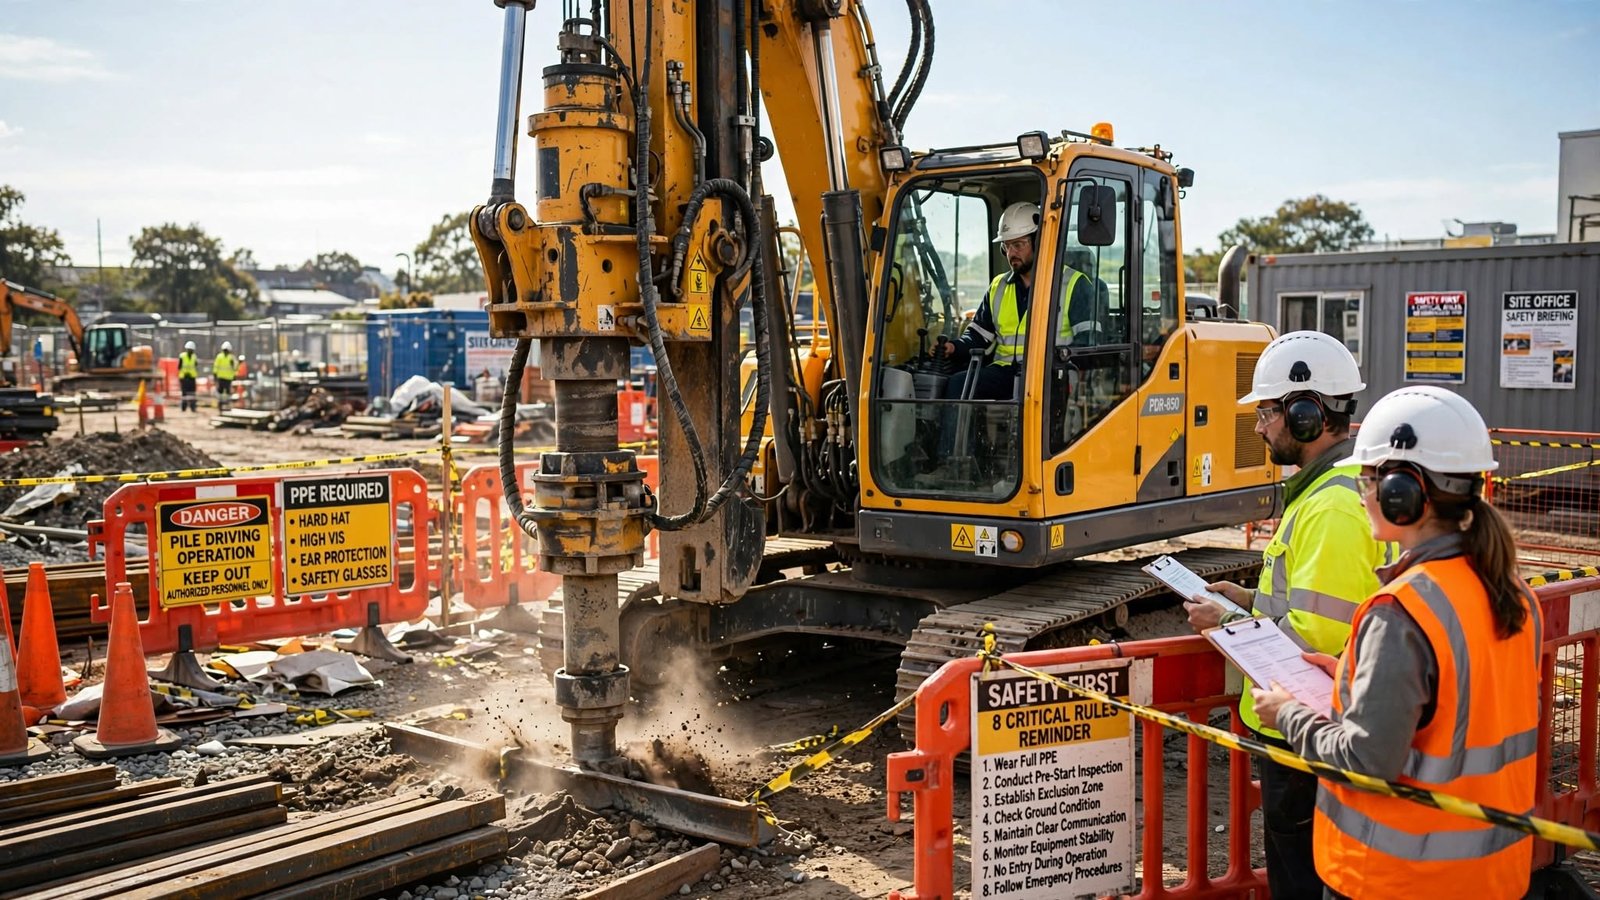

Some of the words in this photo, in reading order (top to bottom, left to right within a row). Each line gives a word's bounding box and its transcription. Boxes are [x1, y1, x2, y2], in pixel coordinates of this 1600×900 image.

[1508, 296, 1531, 308] SITE
[1534, 294, 1570, 308] OFFICE
[1506, 312, 1535, 322] SAFETY
[1537, 310, 1574, 321] BRIEFING
[1149, 397, 1179, 412] PDR-850
[291, 486, 316, 504] PPE
[320, 482, 384, 502] REQUIRED
[180, 506, 250, 524] DANGER
[299, 513, 328, 528] HARD
[331, 511, 350, 525] HAT
[170, 534, 200, 549] PILE
[206, 529, 260, 545] DRIVING
[300, 533, 326, 547] HIGH
[328, 531, 345, 544] VIS
[177, 545, 255, 565] OPERATION
[300, 552, 321, 566] EAR
[324, 546, 387, 564] PROTECTION
[183, 570, 219, 585] KEEP
[224, 566, 251, 581] OUT
[301, 570, 339, 586] SAFETY
[343, 564, 388, 581] GLASSES
[167, 587, 210, 600] AUTHORIZED
[211, 583, 250, 595] PERSONNEL
[252, 580, 268, 590] ONLY
[988, 679, 1061, 708] SAFETY
[1068, 672, 1119, 699] FIRST
[992, 714, 1001, 730] 8
[1006, 706, 1070, 729] CRITICAL
[1075, 702, 1118, 721] RULES
[1020, 723, 1090, 748] REMINDER
[983, 760, 991, 772] 1.
[994, 757, 1018, 771] Wear
[1020, 753, 1037, 768] Full
[1040, 751, 1057, 764] PPE
[983, 777, 992, 790] 2.
[994, 772, 1033, 789] Conduct
[1035, 766, 1076, 783] Pre-Start
[1078, 761, 1123, 778] Inspection
[983, 795, 992, 808] 3.
[995, 789, 1035, 806] Establish
[1038, 784, 1080, 800] Exclusion
[1082, 781, 1104, 794] Zone
[983, 813, 992, 825] 4.
[994, 808, 1022, 824] Check
[1025, 802, 1057, 820] Ground
[1060, 798, 1100, 814] Condition
[983, 831, 991, 843] 5.
[994, 825, 1033, 842] Maintain
[1036, 822, 1058, 835] Clear
[1061, 811, 1126, 830] Communication
[983, 849, 991, 861] 6.
[994, 844, 1028, 860] Monitor
[1030, 835, 1078, 856] Equipment
[1080, 829, 1114, 845] Stability
[983, 866, 991, 879] 7.
[994, 864, 1006, 877] No
[1009, 860, 1033, 875] Entry
[1035, 855, 1063, 869] During
[1065, 847, 1107, 867] Operation
[983, 884, 991, 897] 8.
[994, 880, 1023, 895] Follow
[1026, 871, 1073, 889] Emergency
[1075, 862, 1122, 880] Procedures
